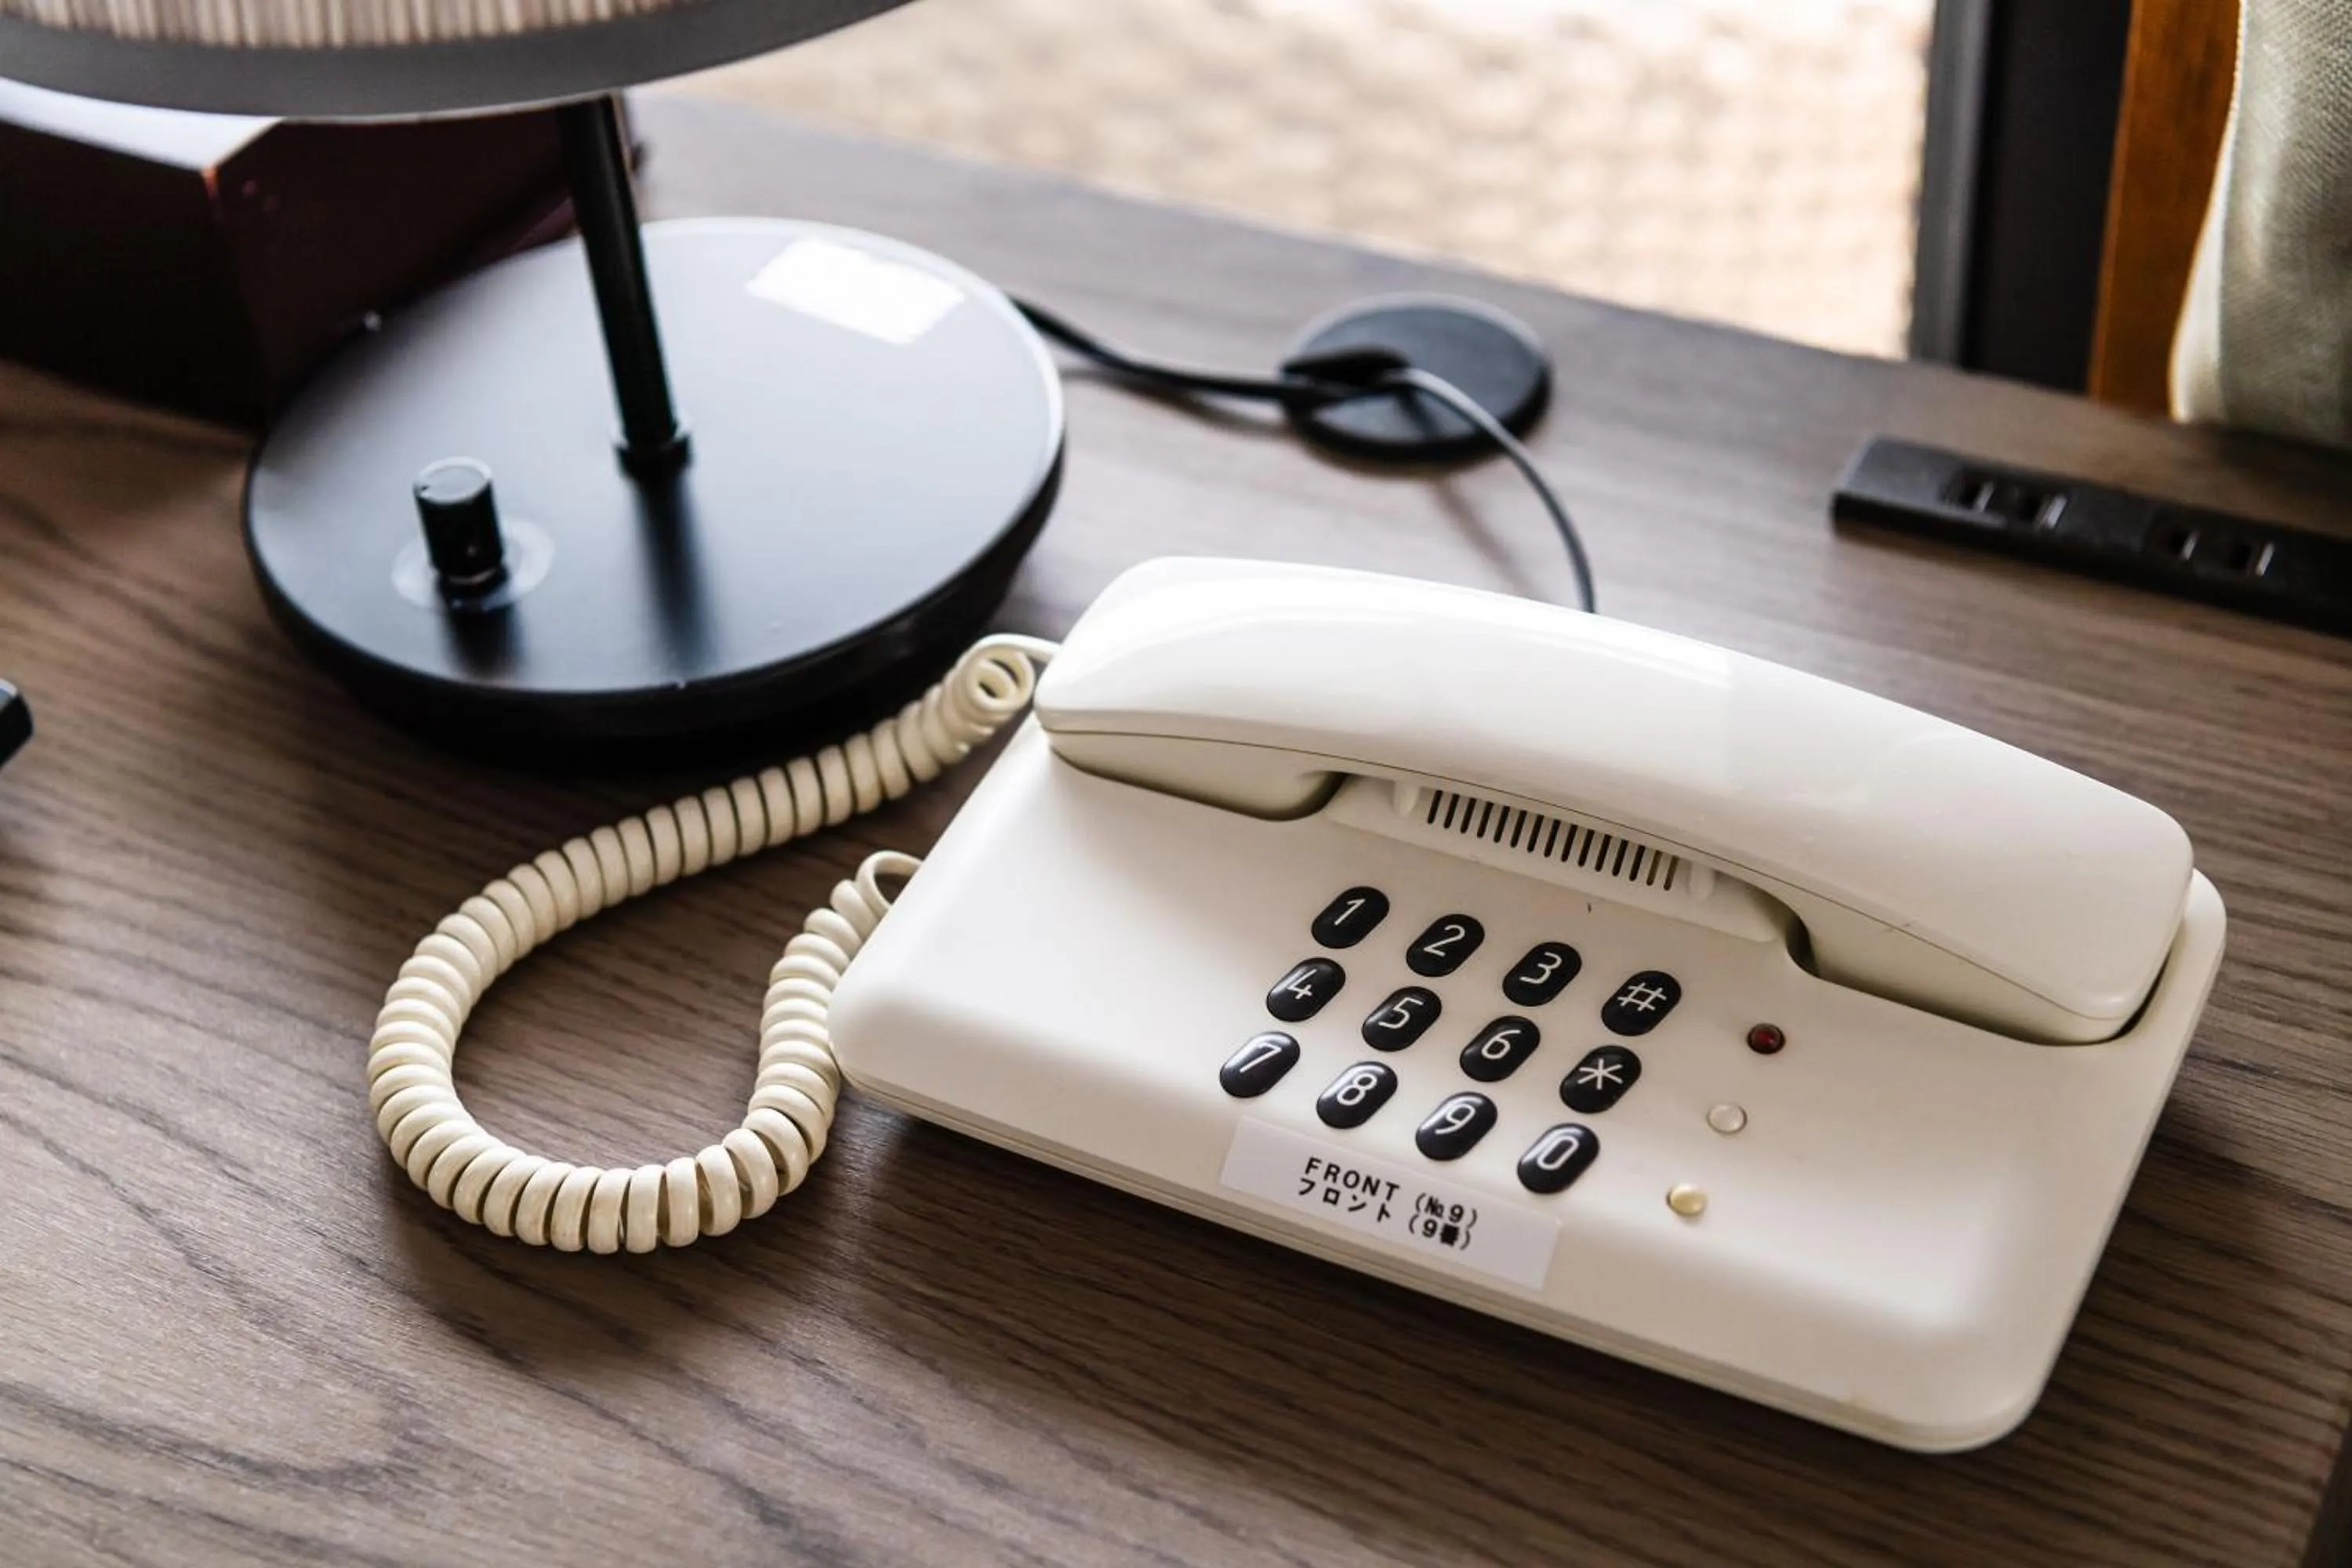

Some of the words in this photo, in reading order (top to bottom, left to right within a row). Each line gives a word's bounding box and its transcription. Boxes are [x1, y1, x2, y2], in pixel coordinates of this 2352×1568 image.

[1334, 898, 1365, 925] 1
[1423, 924, 1465, 956] 2
[1519, 952, 1562, 984] 3
[1287, 969, 1317, 1000] 4
[1617, 982, 1668, 1011] #
[1377, 997, 1424, 1029] 5
[1239, 1042, 1282, 1073] 7
[1481, 1029, 1522, 1059] 6
[1337, 1073, 1377, 1106] 8
[1434, 1103, 1475, 1134] 9
[1537, 1135, 1579, 1171] 0
[1304, 1156, 1400, 1201] FRONT
[1298, 1178, 1392, 1222] フロント
